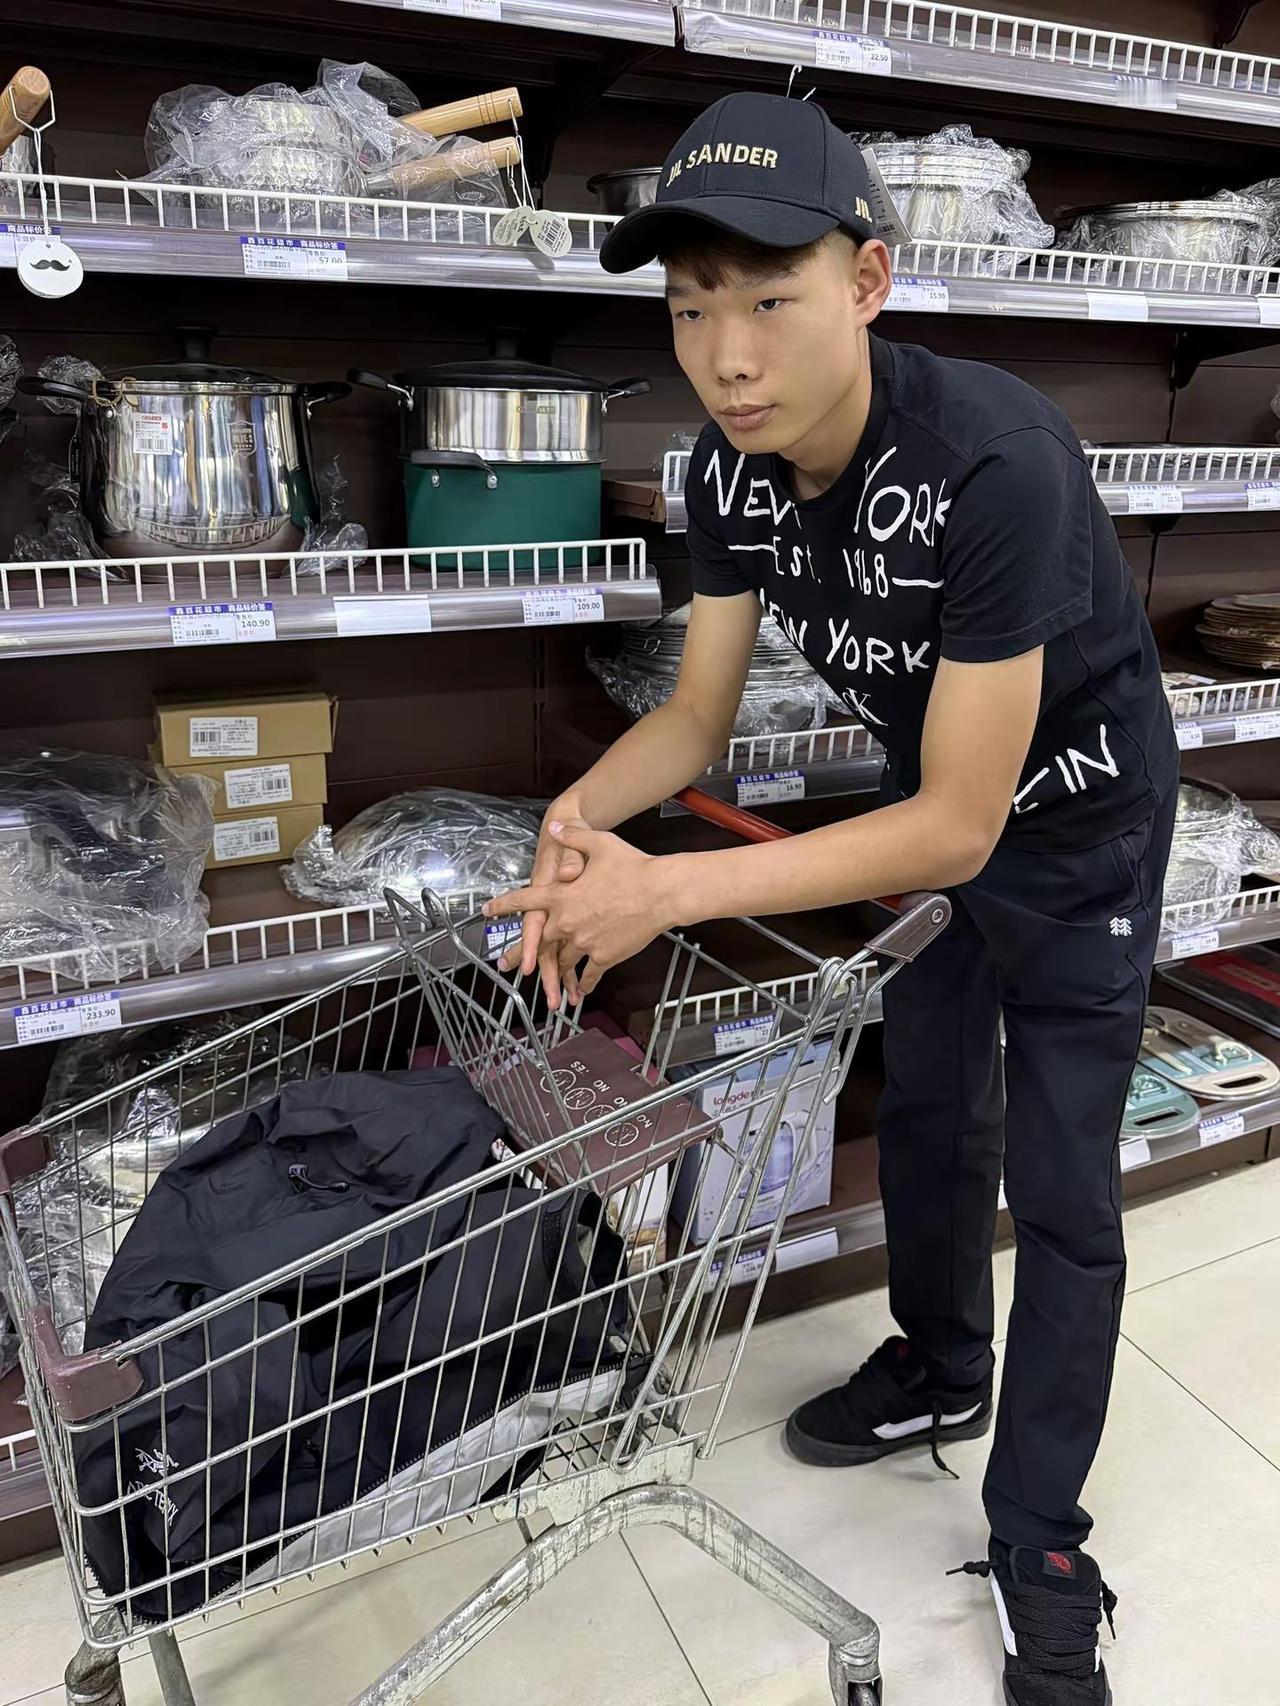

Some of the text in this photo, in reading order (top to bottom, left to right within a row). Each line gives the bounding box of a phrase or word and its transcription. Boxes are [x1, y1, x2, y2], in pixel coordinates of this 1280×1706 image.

[685, 142, 779, 170] SANDER
[853, 446, 953, 547] YORK
[577, 602, 601, 610] 109.00
[241, 619, 271, 628] 140.90
[826, 618, 931, 675] YORK
[86, 1009, 116, 1020] 233.90
[570, 1061, 590, 1077] ES
[593, 1079, 611, 1093] NO
